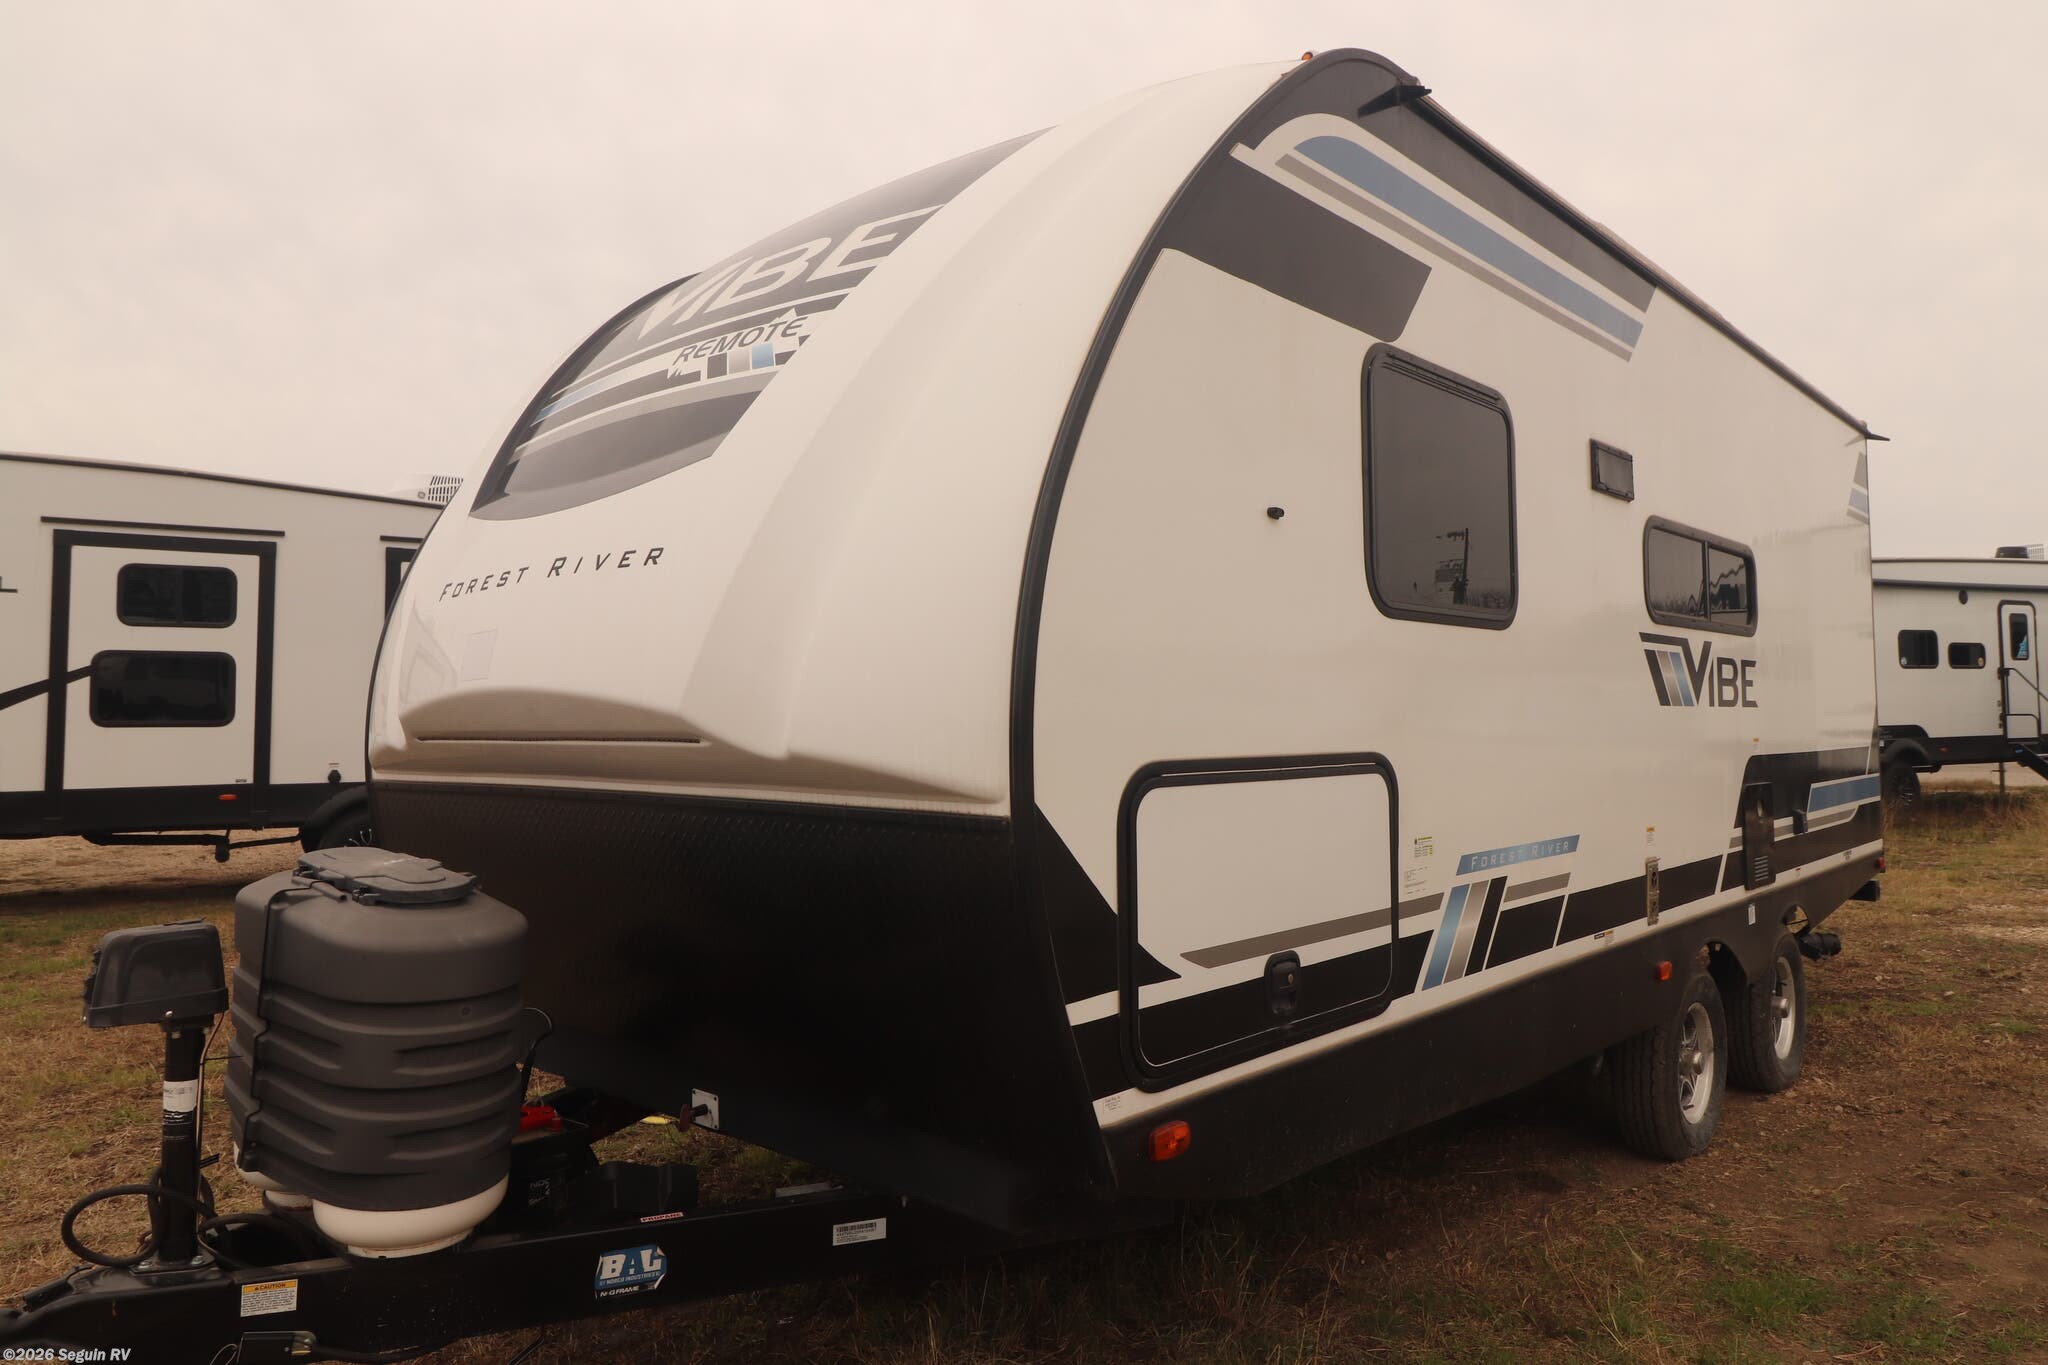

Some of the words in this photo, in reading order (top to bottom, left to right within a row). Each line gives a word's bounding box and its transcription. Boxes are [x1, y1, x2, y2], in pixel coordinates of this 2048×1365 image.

[638, 203, 948, 340] VIBE
[672, 316, 809, 366] REMOTE
[438, 566, 530, 602] FOREST
[547, 547, 664, 578] RIVER
[1640, 632, 1758, 708] VIBE
[1471, 849, 1525, 871] FOREST
[1532, 840, 1570, 857] RIVER
[600, 1248, 662, 1280] BAL
